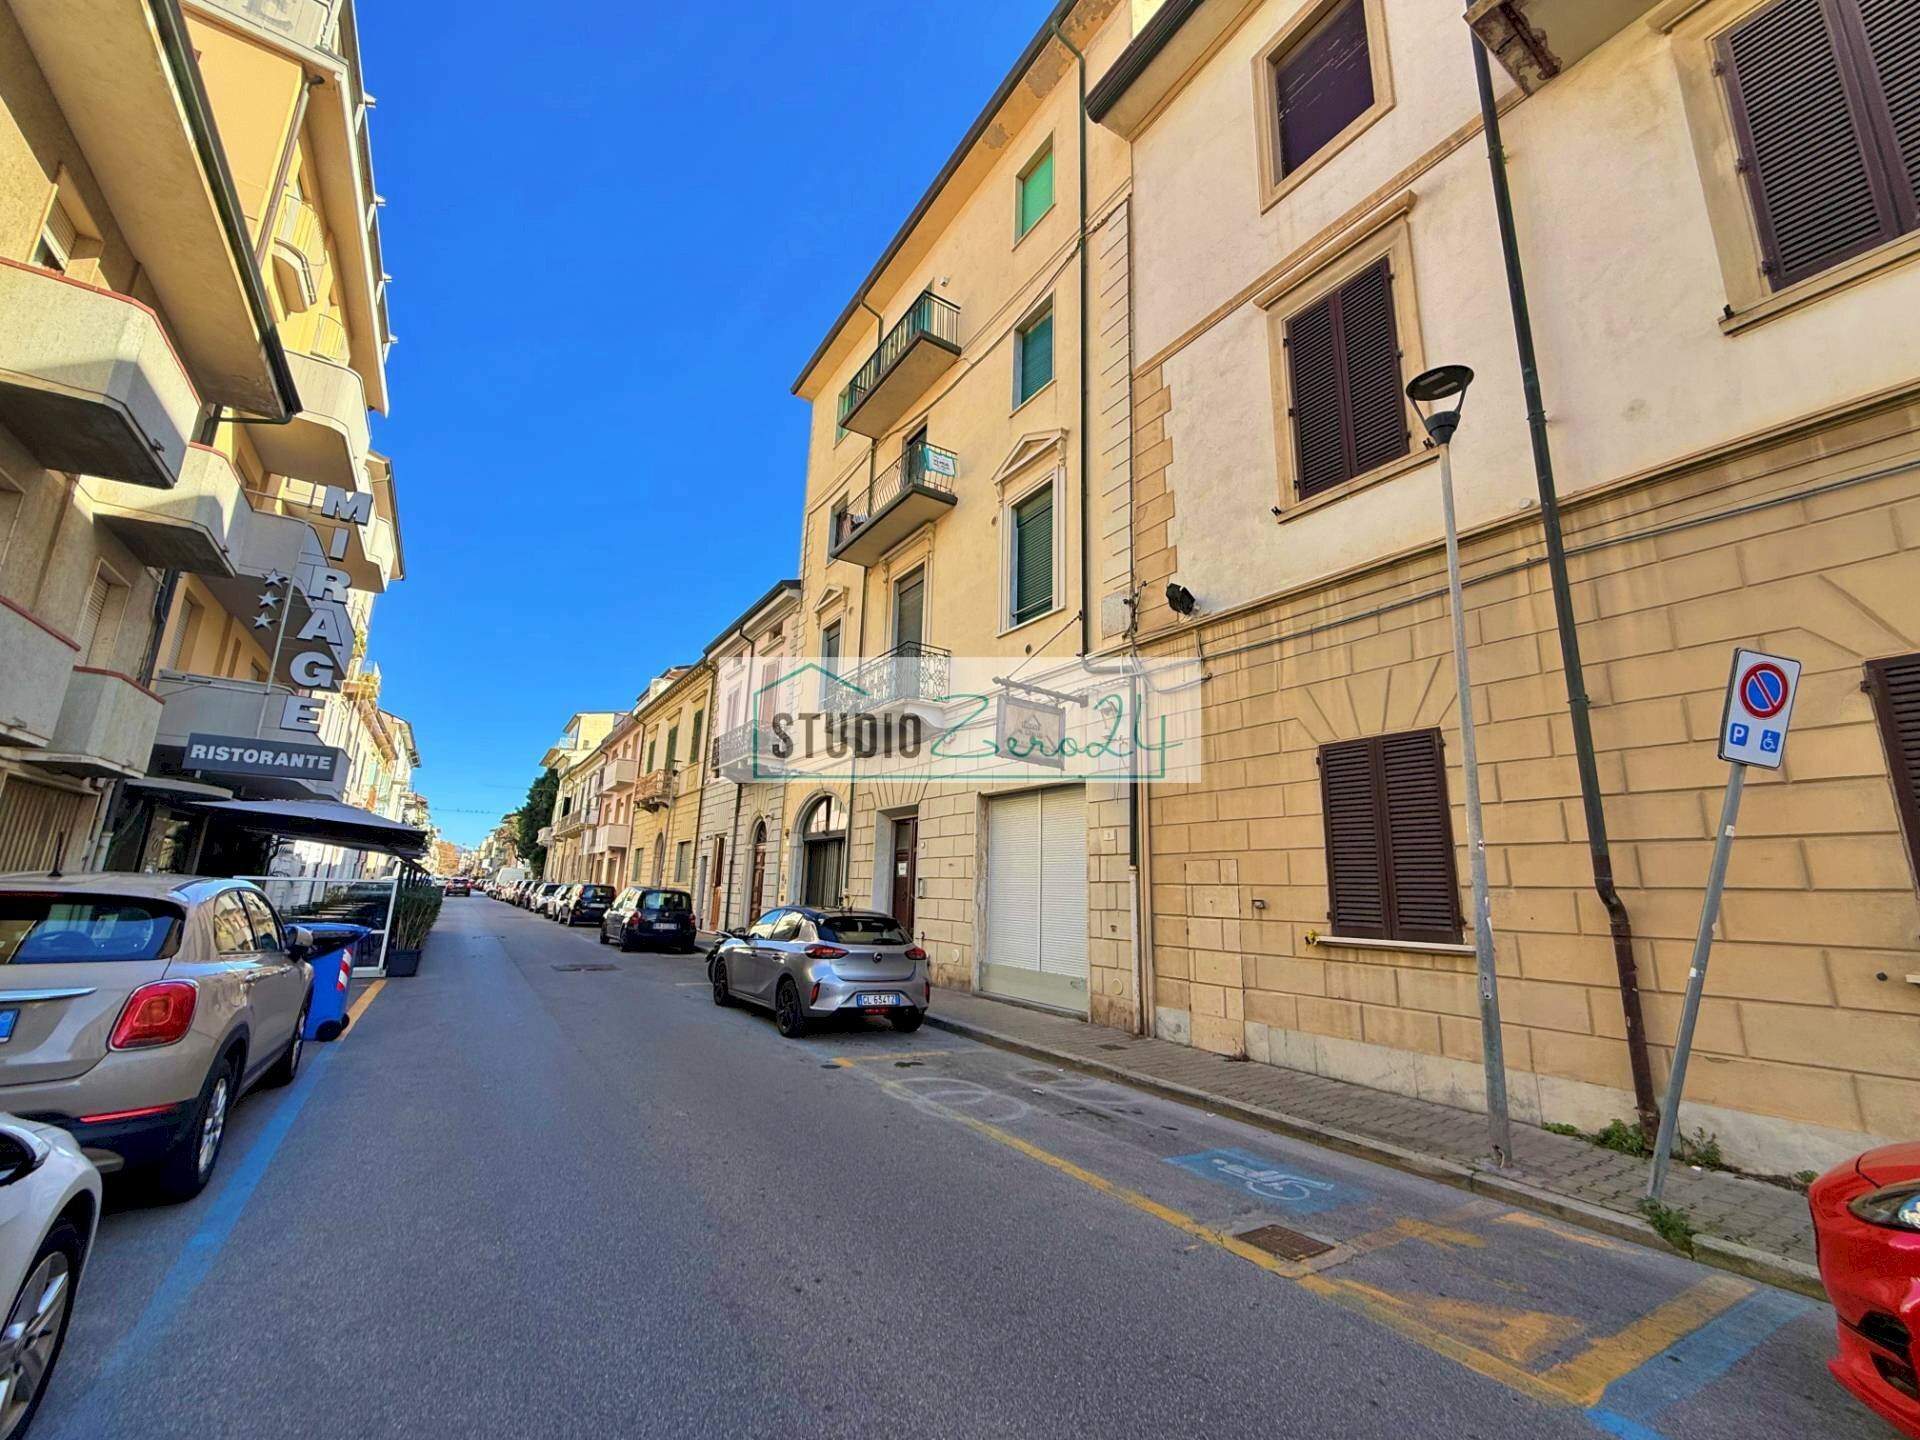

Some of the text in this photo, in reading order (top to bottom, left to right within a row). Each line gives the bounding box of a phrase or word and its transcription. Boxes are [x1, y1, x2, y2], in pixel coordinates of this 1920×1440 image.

[281, 486, 372, 733] MIRAGE
[1733, 726, 1746, 742] P
[190, 744, 332, 770] RISTORANTE
